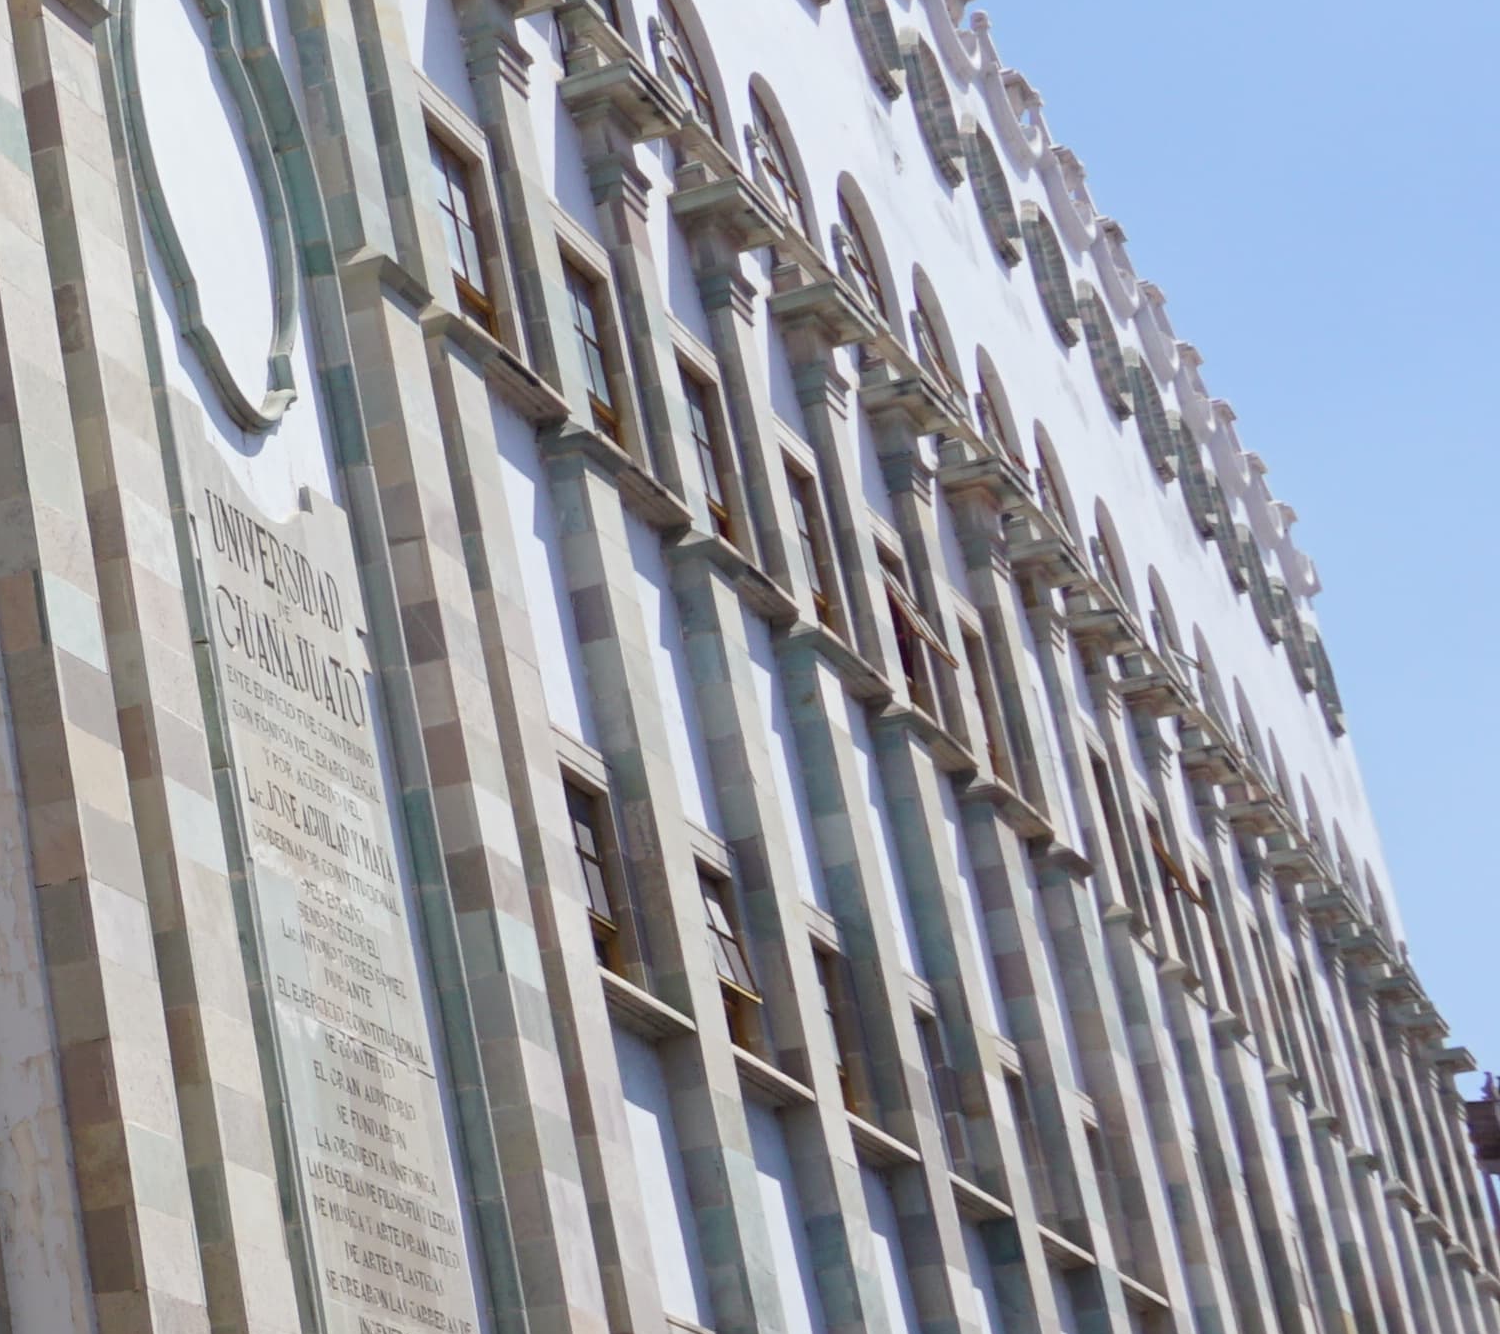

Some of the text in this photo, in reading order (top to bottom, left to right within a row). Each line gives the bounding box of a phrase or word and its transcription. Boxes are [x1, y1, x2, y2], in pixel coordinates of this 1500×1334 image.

[205, 488, 343, 634] UNIVERSIDAD
[215, 585, 366, 728] GUANAJUATO
[225, 663, 252, 694] ESTE
[296, 707, 317, 734] FUE
[231, 698, 253, 724] CON
[293, 735, 314, 762] DEL
[301, 804, 349, 856] AGUILAR
[359, 835, 394, 884] MAYA
[314, 1127, 332, 1152] LA
